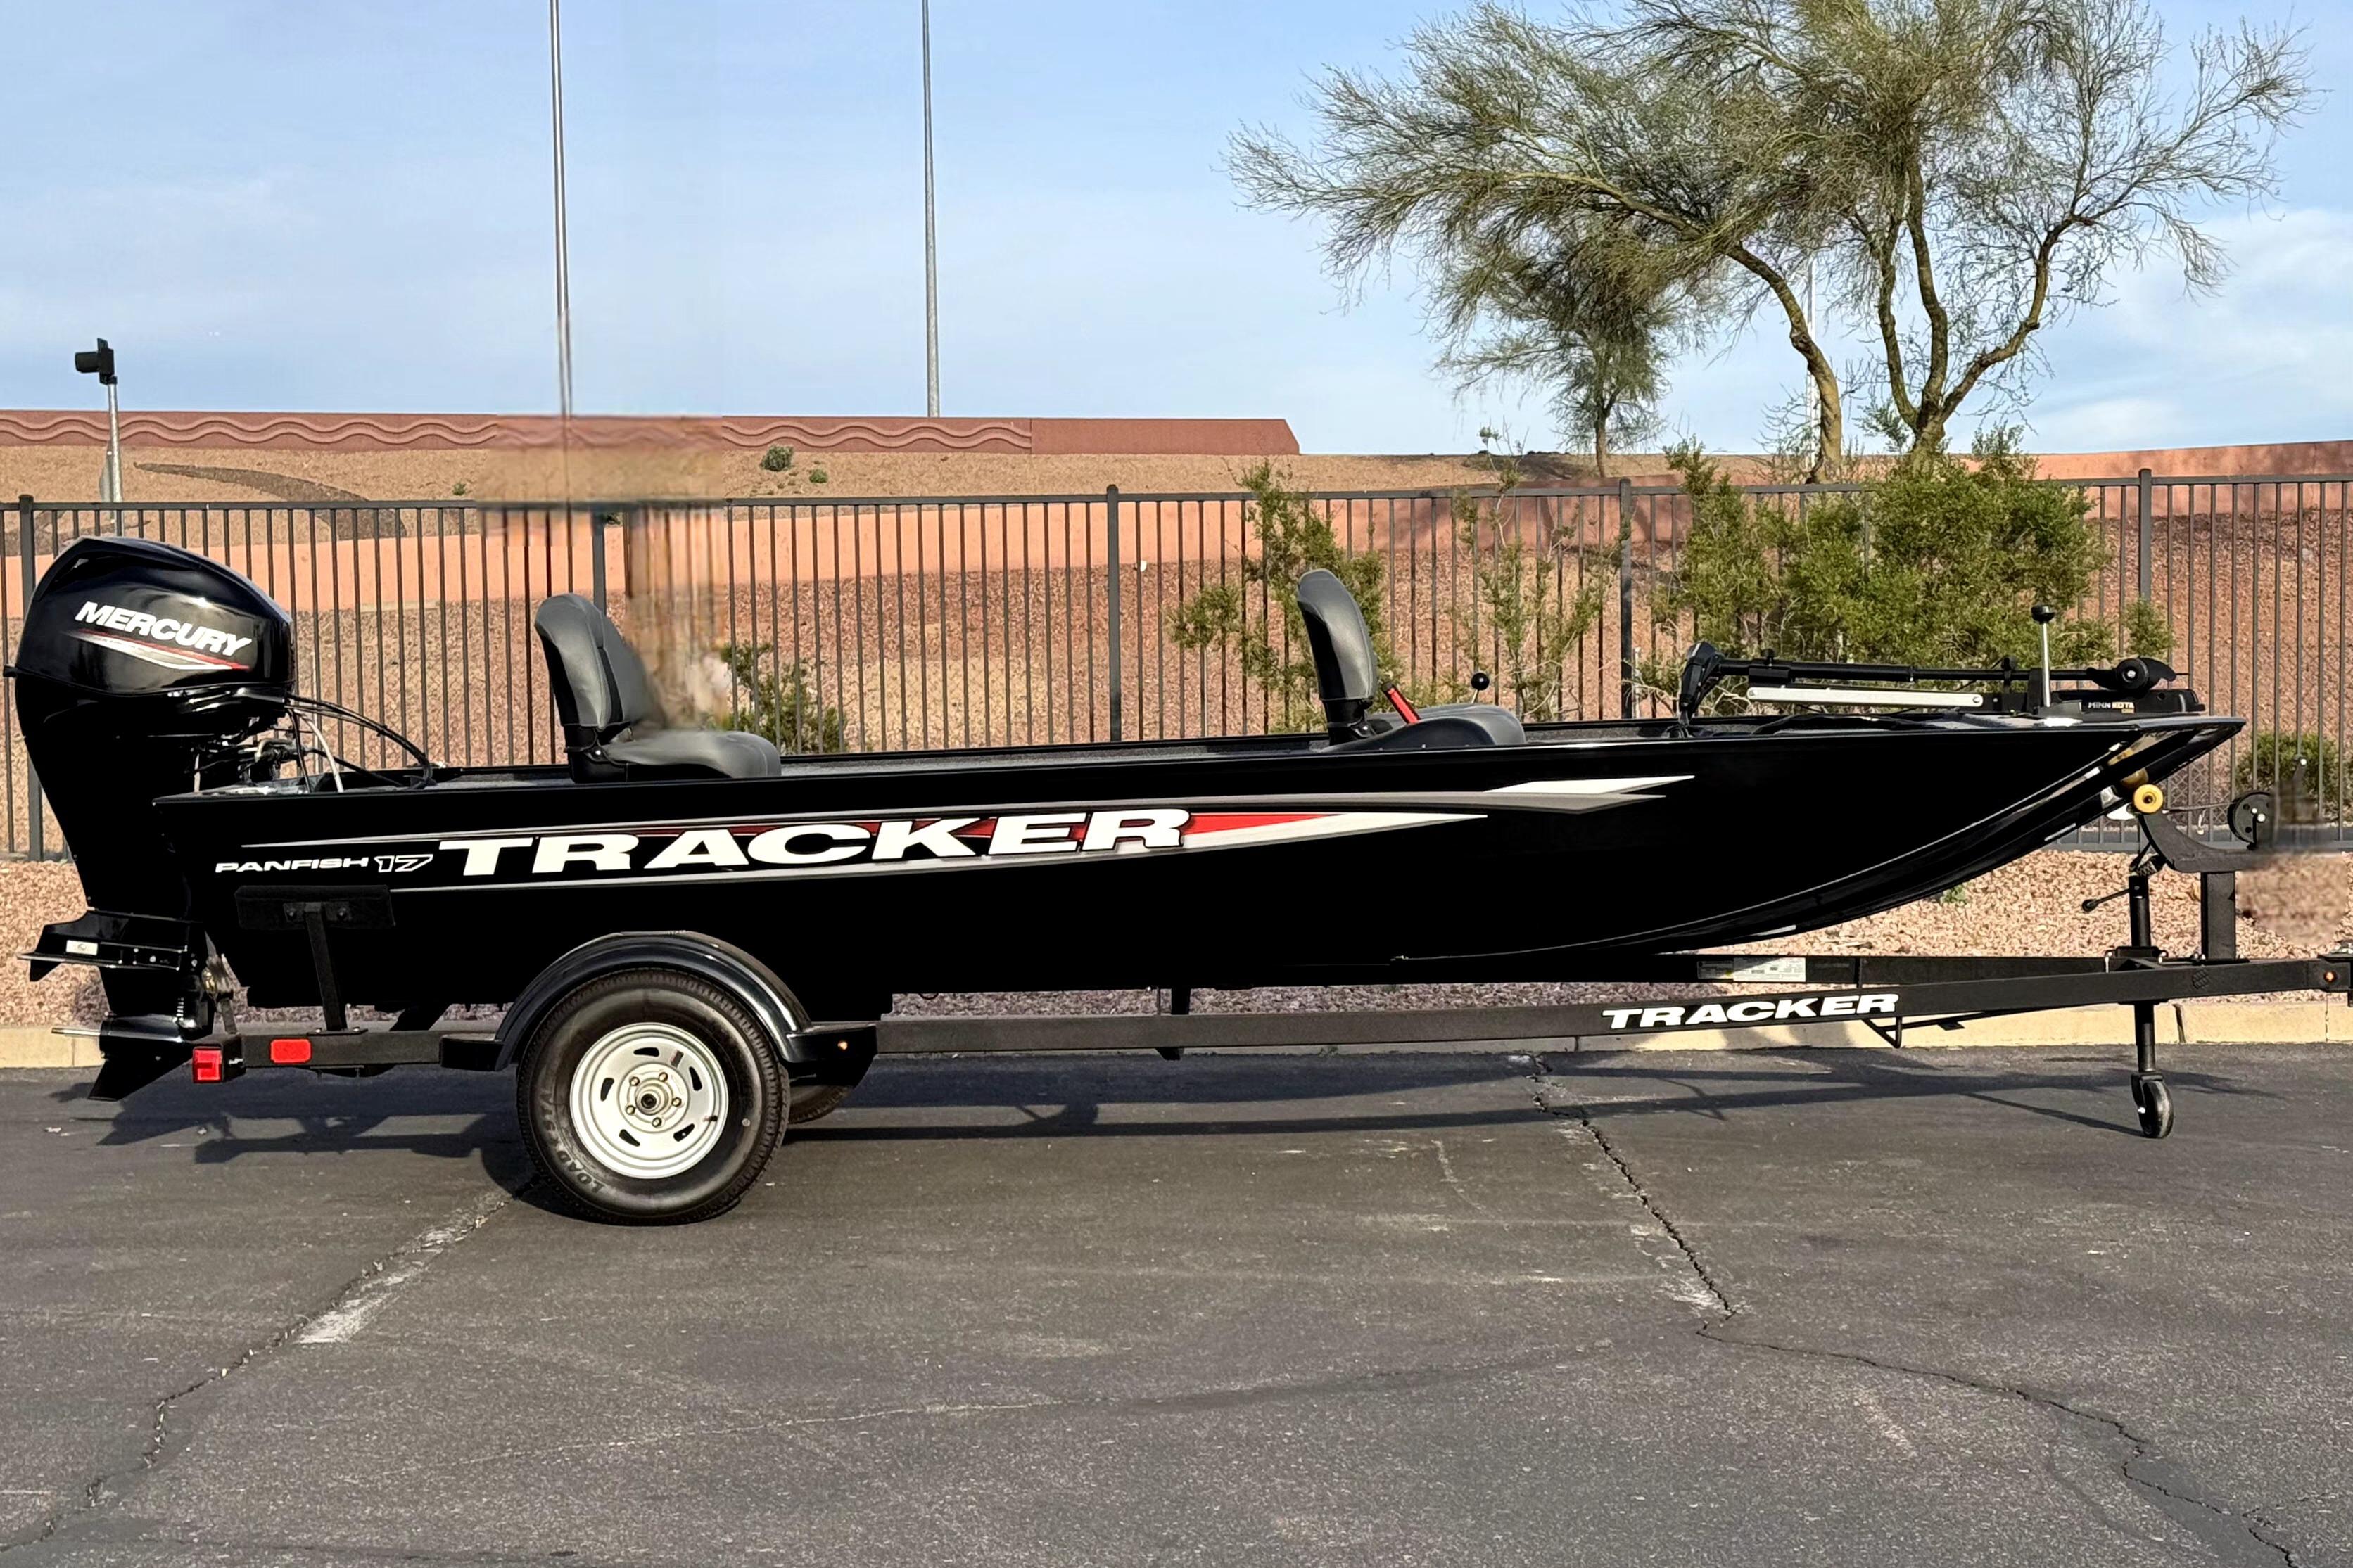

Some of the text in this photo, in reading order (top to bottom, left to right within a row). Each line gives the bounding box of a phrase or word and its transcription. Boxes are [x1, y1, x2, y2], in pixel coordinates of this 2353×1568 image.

[75, 601, 253, 657] MERCURY
[215, 854, 434, 873] PANFISH 17
[438, 808, 1191, 877] TRACKER
[1602, 994, 1899, 1029] TRACKER
